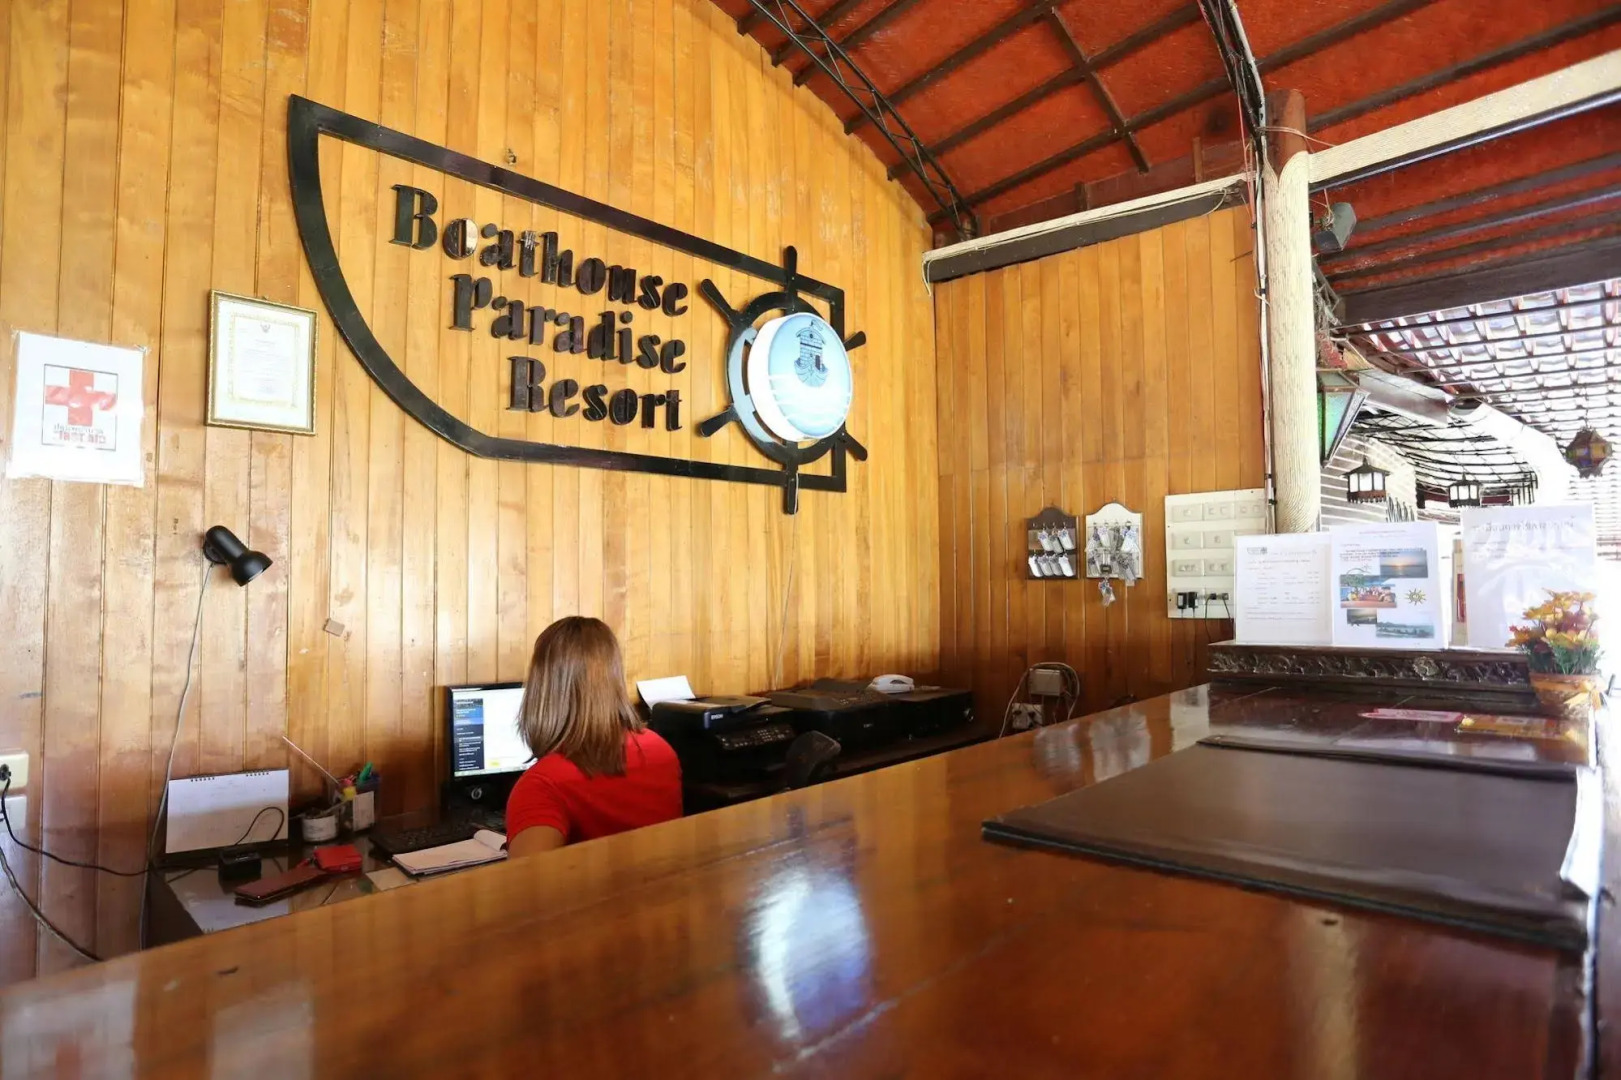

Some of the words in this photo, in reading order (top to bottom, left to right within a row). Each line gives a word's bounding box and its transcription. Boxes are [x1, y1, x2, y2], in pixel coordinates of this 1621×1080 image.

[389, 184, 688, 316] Boathouse
[449, 274, 686, 373] Paradise
[506, 356, 682, 431] Resort
